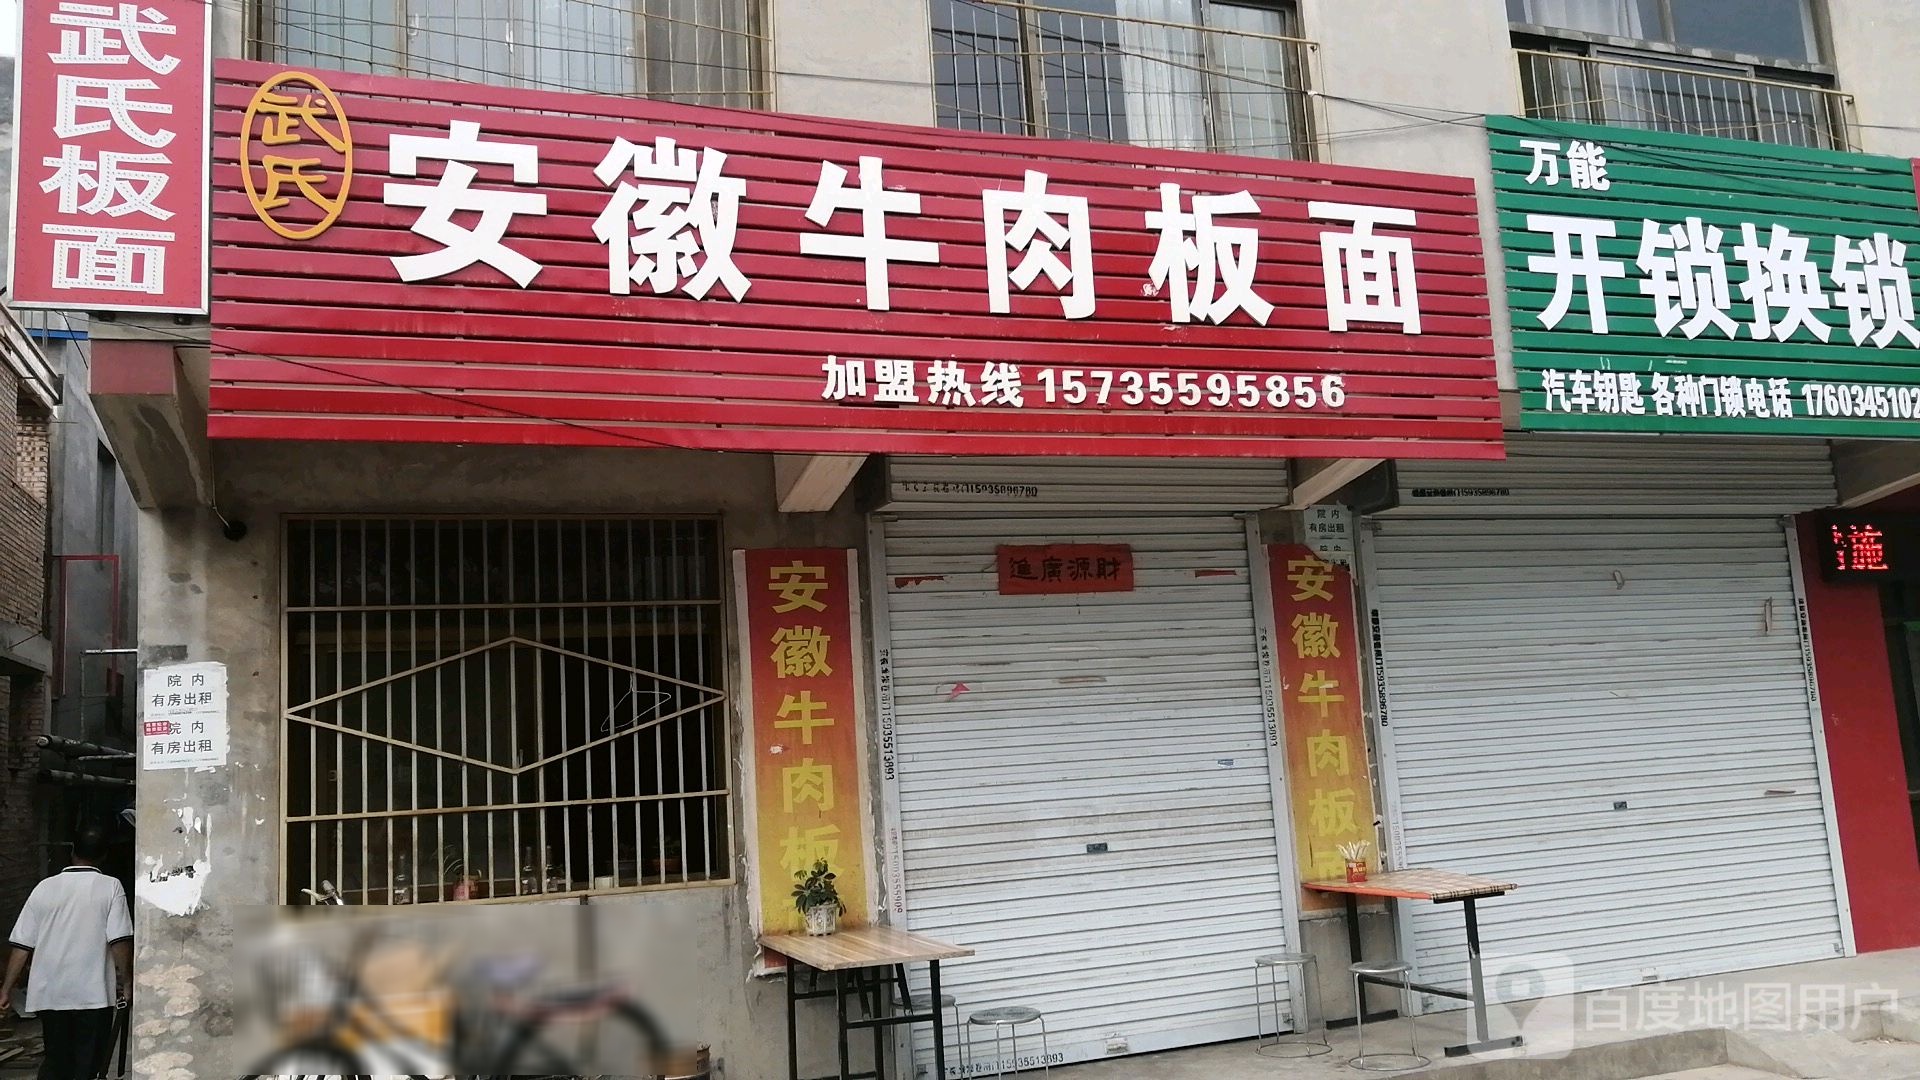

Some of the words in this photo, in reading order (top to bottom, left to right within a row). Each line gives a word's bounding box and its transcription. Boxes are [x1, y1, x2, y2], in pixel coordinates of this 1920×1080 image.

[40, 2, 181, 295] 武氏板面
[256, 92, 346, 215] 武氏
[1519, 139, 1611, 192] 万能
[383, 119, 1422, 335] 安徽牛肉板面
[1526, 214, 1919, 349] 开锁换锁
[821, 355, 1024, 408] 加盟热线
[1037, 368, 1346, 409] 15735595856
[1541, 368, 1646, 416] 汽车钥匙
[1650, 371, 1794, 418] 各种门锁电话
[1801, 383, 1920, 419] 1760345102
[151, 691, 212, 707] 有房出租
[167, 673, 204, 688] 院内
[151, 739, 212, 755] 有房出租
[767, 560, 846, 928] 安徽牛肉板
